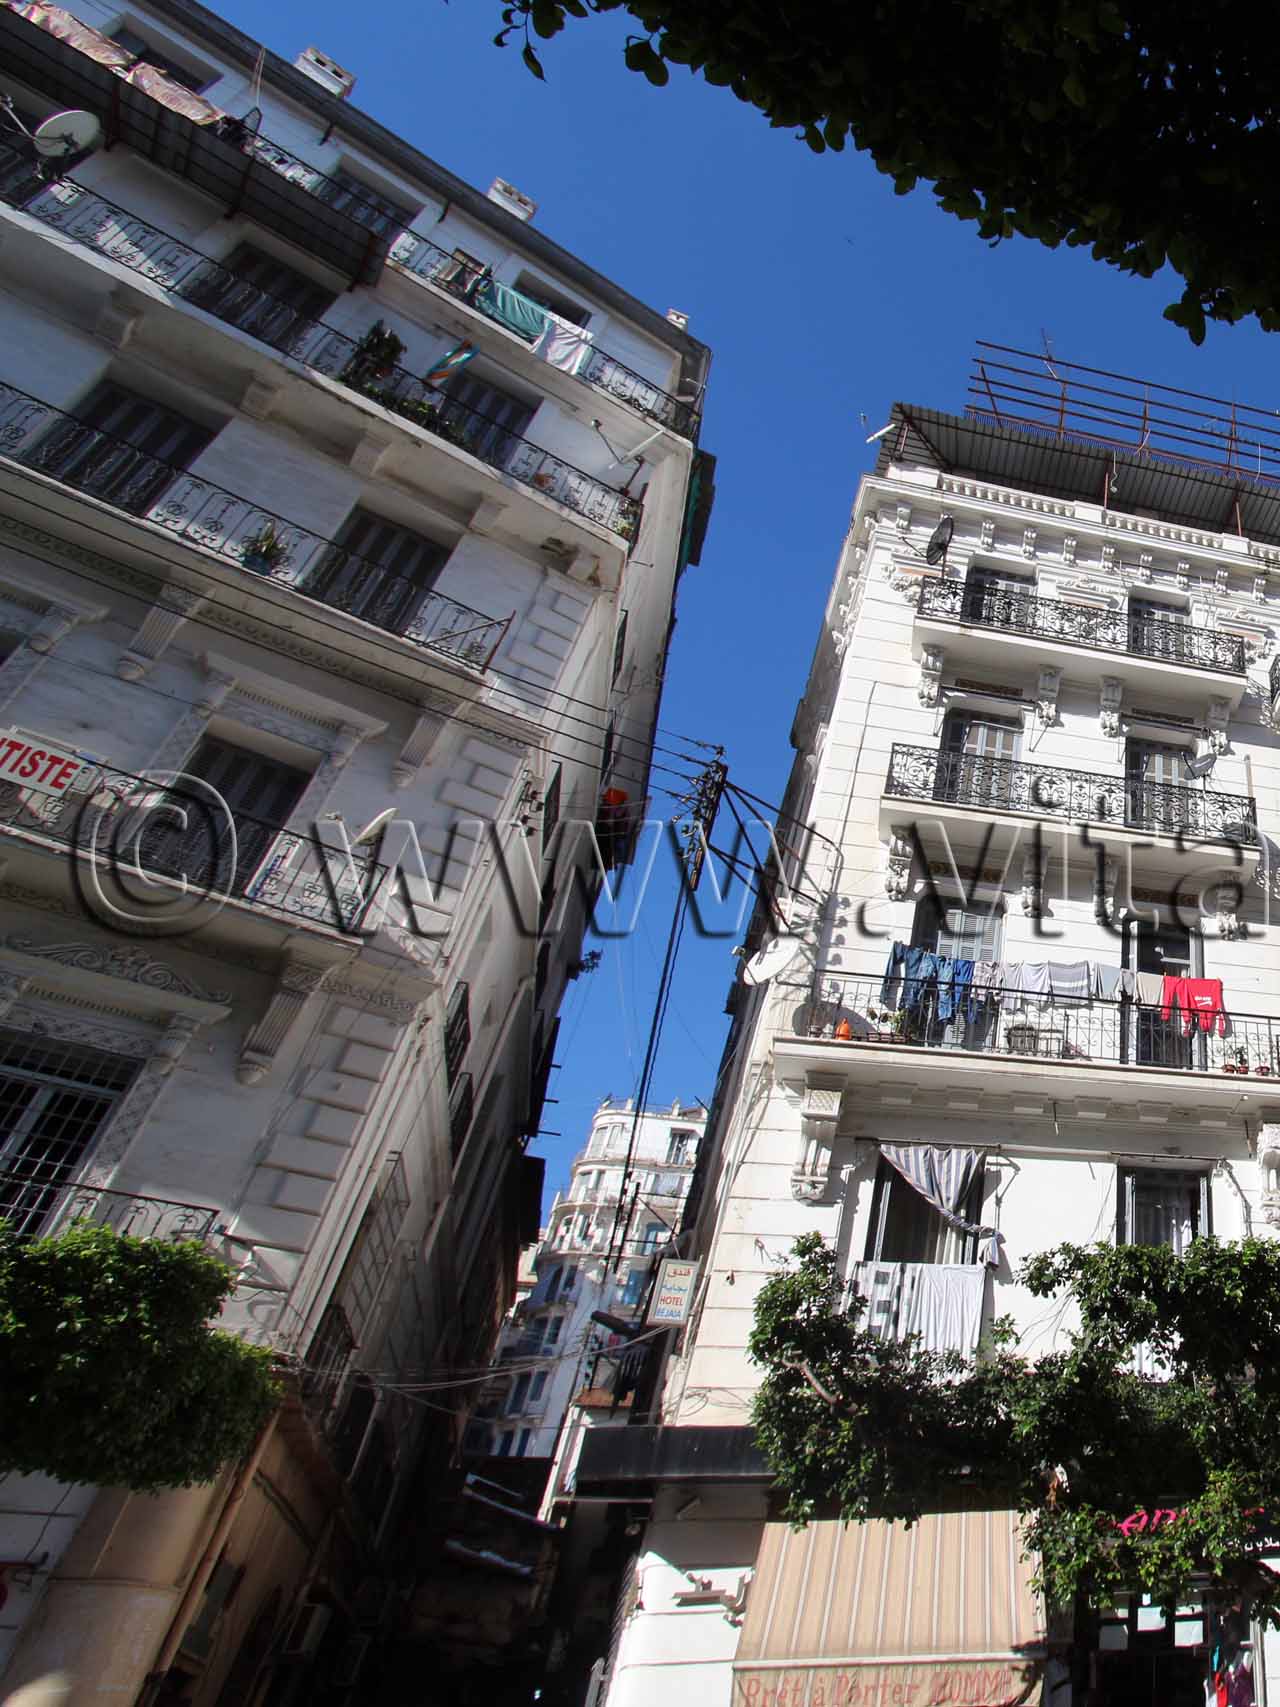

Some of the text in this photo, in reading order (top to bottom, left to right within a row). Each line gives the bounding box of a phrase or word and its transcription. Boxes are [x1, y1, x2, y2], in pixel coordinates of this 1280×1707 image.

[0, 738, 80, 789] TISTE
[659, 1295, 684, 1306] HOTEL
[834, 1671, 922, 1707] Porter
